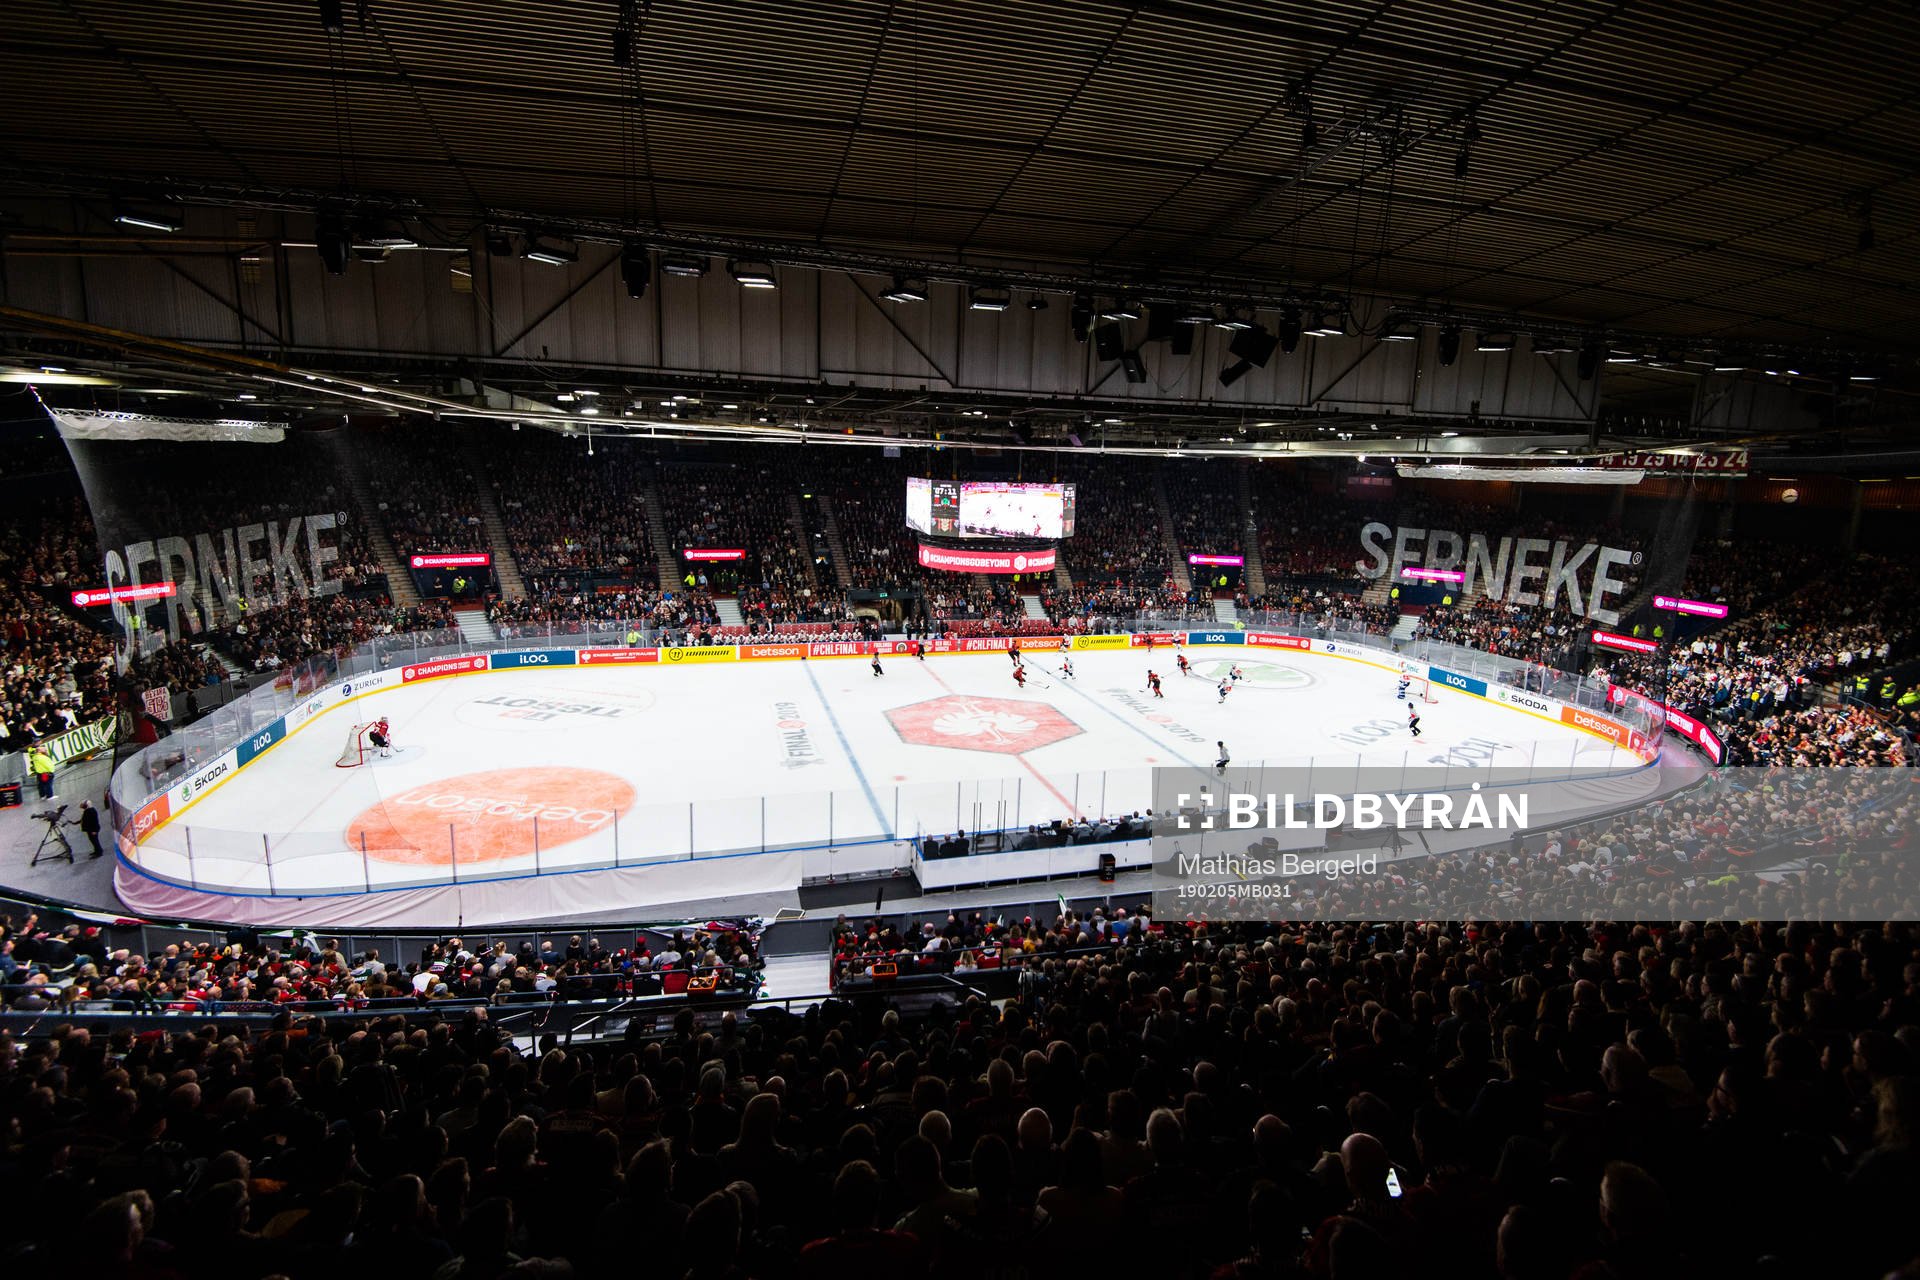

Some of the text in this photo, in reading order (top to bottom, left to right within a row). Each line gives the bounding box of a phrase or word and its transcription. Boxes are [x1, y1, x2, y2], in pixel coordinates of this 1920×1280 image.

[1724, 452, 1748, 467] 24
[930, 554, 1011, 568] #CHAMPIONSGOBEYOND
[966, 638, 1007, 651] #CHLFINAL
[1021, 639, 1061, 649] betsson
[1205, 634, 1226, 642] iLOQ
[752, 646, 799, 657] betsson
[813, 643, 858, 656] #CHLFINAL
[519, 653, 549, 664] iLOQ
[417, 660, 458, 676] CHAMPIONS
[354, 677, 384, 691] ZURICH
[1446, 674, 1467, 688] iLOQ
[473, 696, 623, 718] TISSOT
[1574, 712, 1621, 738] betsson
[253, 732, 272, 752] iLOQ
[194, 762, 228, 791] ŠKODA
